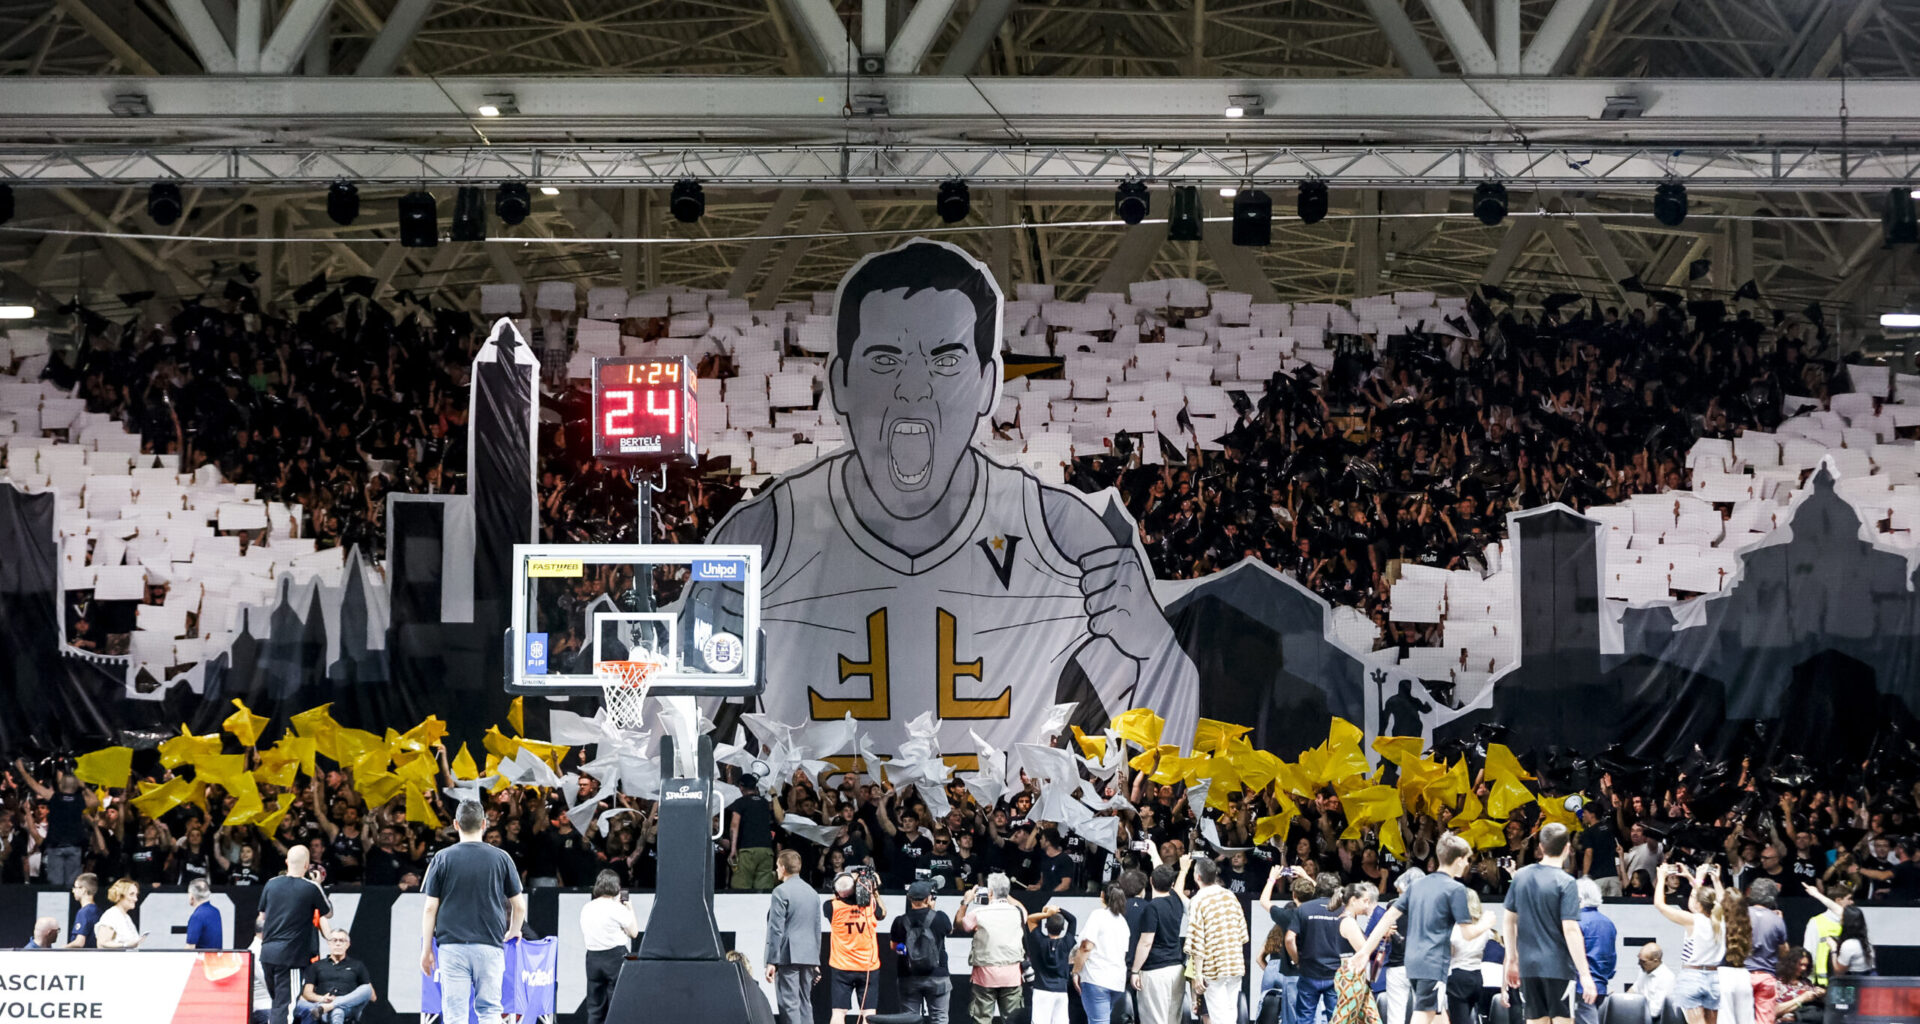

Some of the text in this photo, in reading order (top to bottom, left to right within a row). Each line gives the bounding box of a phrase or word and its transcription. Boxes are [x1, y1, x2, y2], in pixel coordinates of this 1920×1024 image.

[628, 363, 679, 384] 1:24
[605, 389, 676, 435] 24
[703, 562, 737, 579] Unipol
[975, 533, 1023, 591] V
[528, 659, 545, 667] FIP
[665, 790, 703, 800] SPALDING
[844, 921, 866, 935] TV
